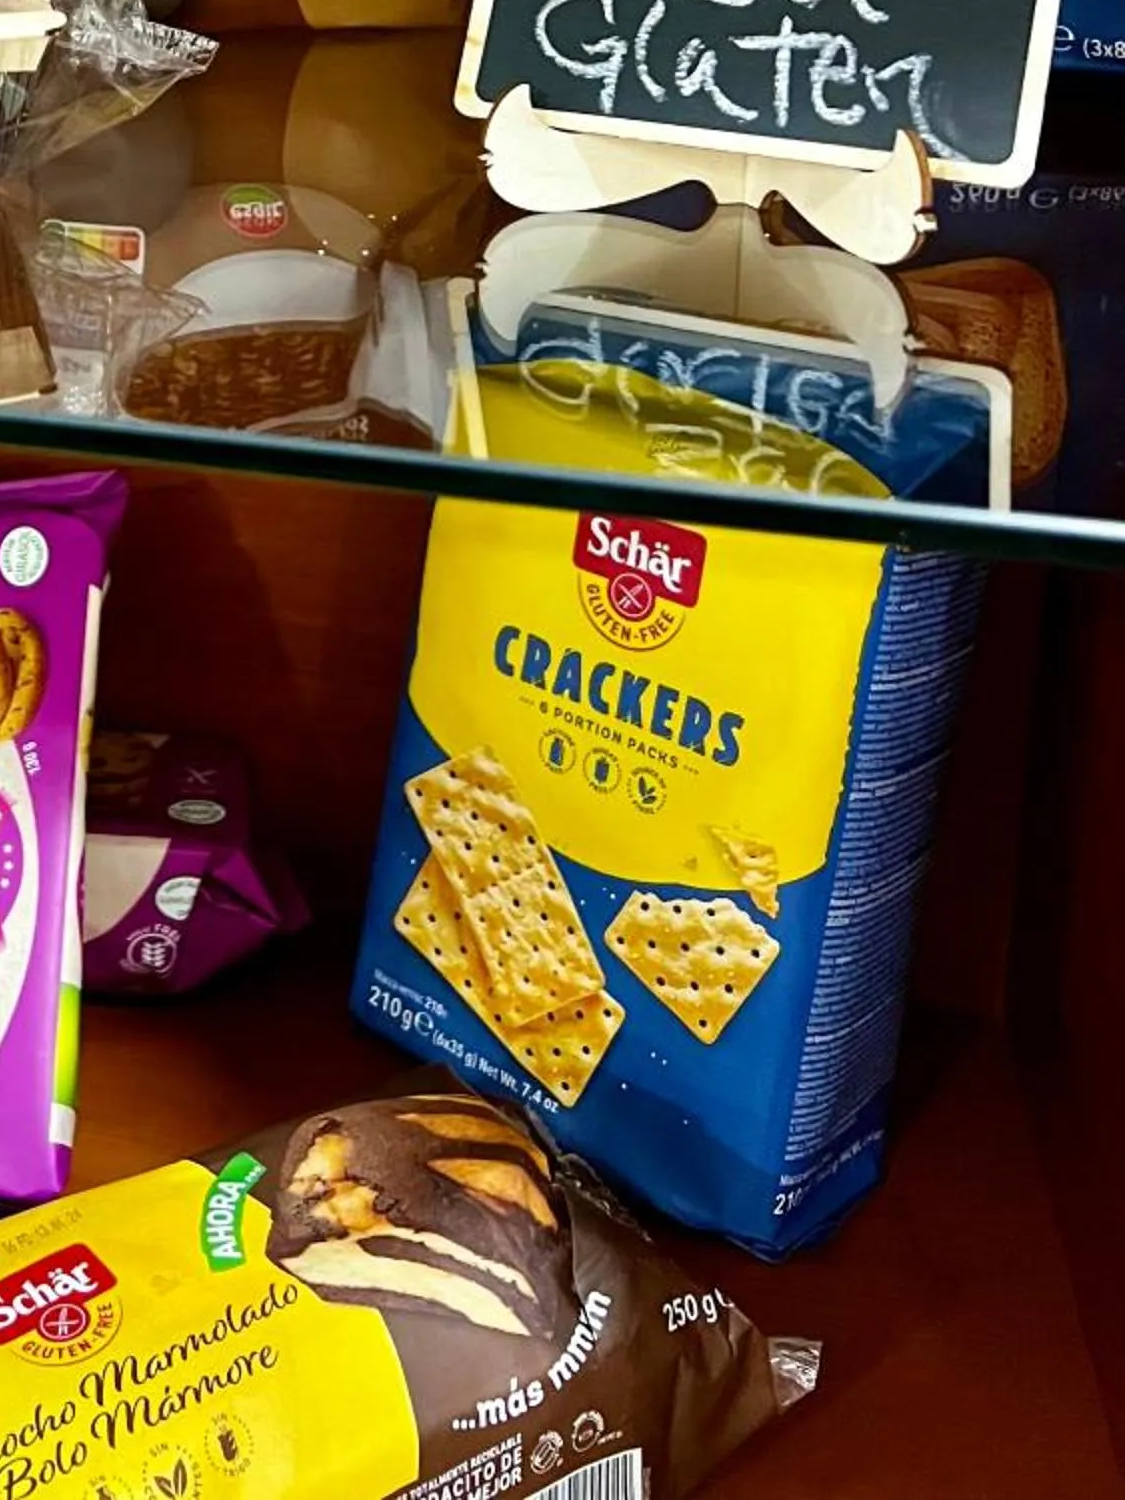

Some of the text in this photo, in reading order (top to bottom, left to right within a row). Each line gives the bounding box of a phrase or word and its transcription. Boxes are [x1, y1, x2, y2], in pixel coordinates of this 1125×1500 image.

[586, 516, 692, 593] Schär
[585, 583, 676, 644] GLUTEN-FREE
[493, 625, 747, 767] CRACKERS
[553, 707, 623, 745] PORTION
[626, 737, 679, 770] PACKS
[367, 985, 403, 1018] 210
[478, 1057, 498, 1080] Net
[22, 1301, 114, 1360] GLUTEN-FREE
[662, 1293, 699, 1333] 250
[78, 1283, 299, 1411] Marmolado
[90, 1343, 279, 1450] Mármore
[469, 1432, 523, 1471] RECICLABLE
[499, 1445, 523, 1473] DE
